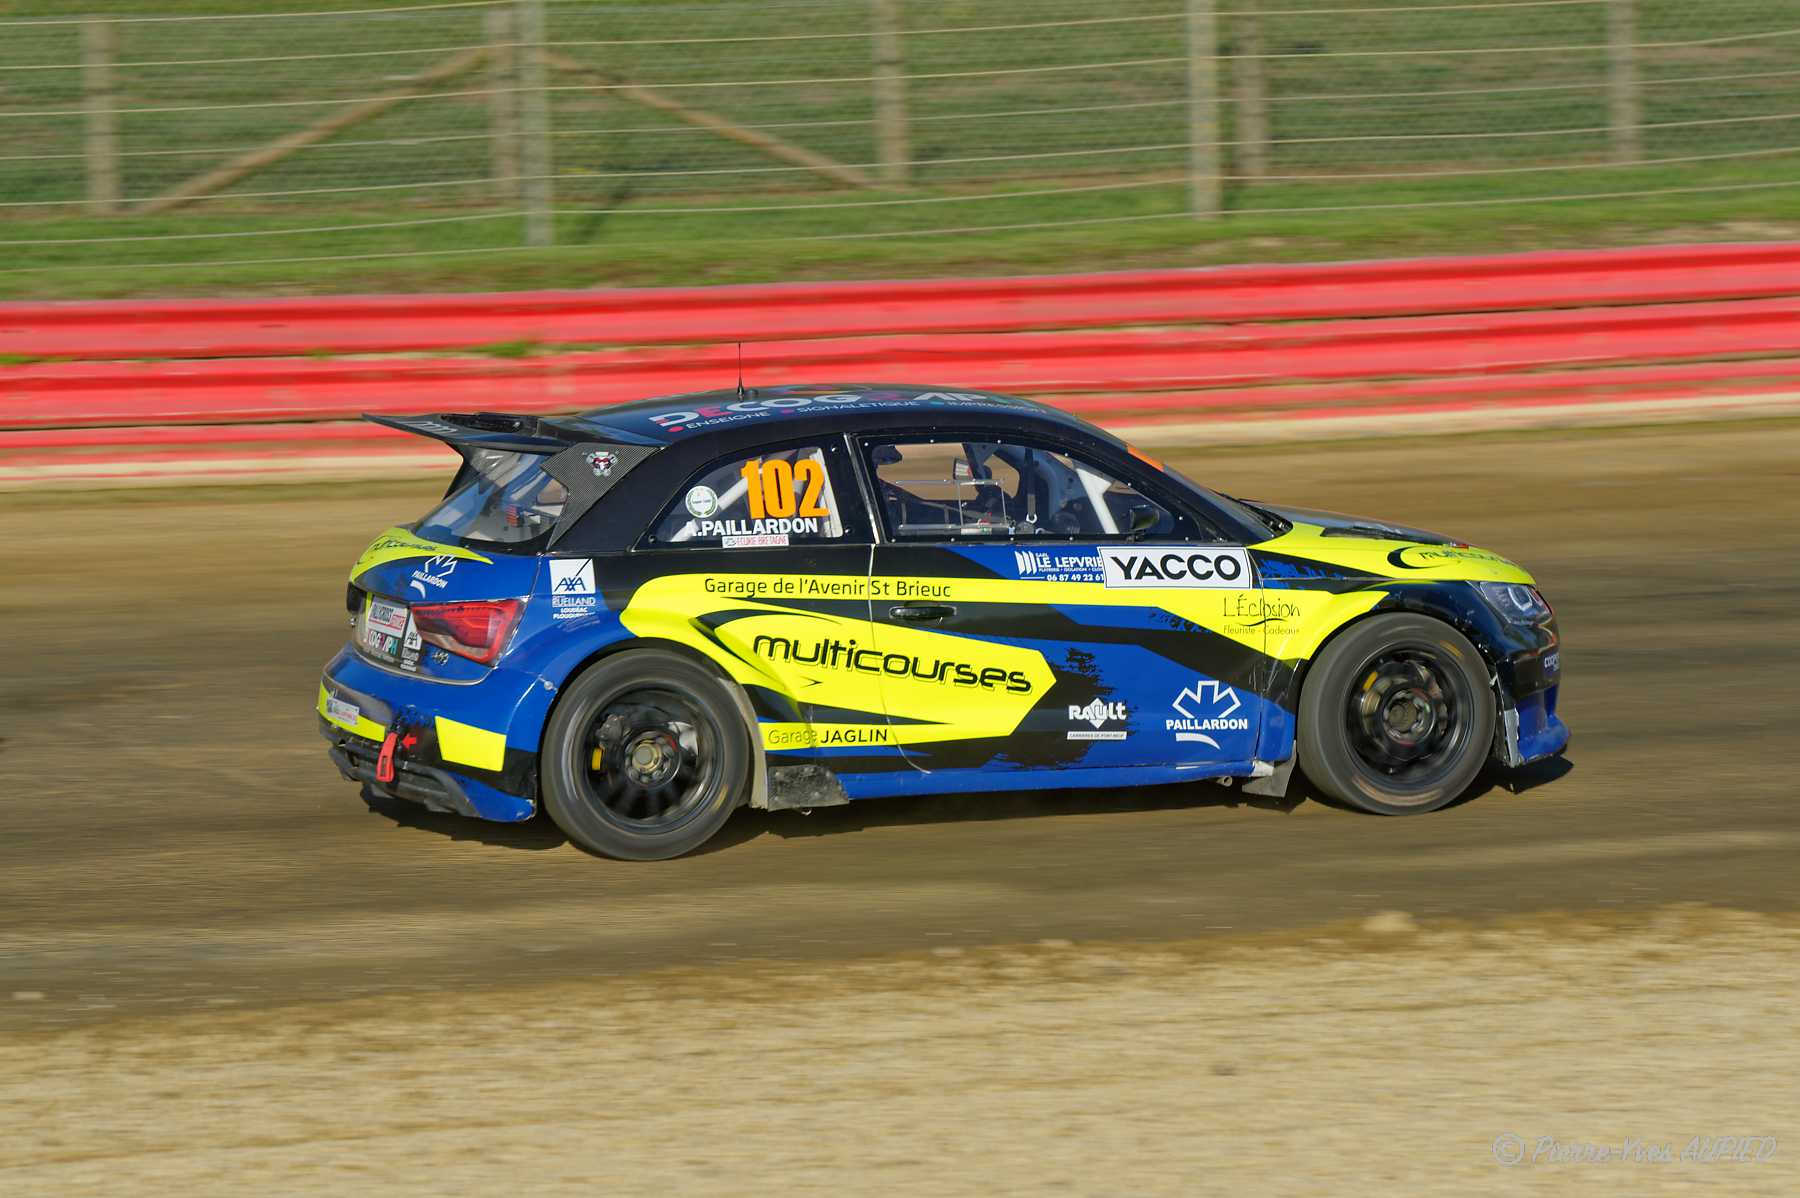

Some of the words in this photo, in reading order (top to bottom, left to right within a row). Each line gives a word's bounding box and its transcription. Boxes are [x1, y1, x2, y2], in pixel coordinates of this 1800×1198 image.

[686, 411, 771, 429] ENSEIGNE
[740, 458, 830, 519] 102
[685, 517, 818, 537] A.PAILLARDON
[1037, 557, 1051, 568] LE
[1111, 554, 1242, 581] YACCO
[554, 577, 586, 592] AXA
[1047, 574, 1057, 582] 06
[1059, 574, 1069, 582] 87
[1071, 574, 1082, 582] 49
[1083, 574, 1094, 582] 22
[705, 578, 767, 597] Garage
[773, 578, 794, 594] de
[799, 579, 865, 595] l'Avenir
[871, 580, 889, 595] St
[897, 581, 951, 597] Brieuc
[753, 635, 1033, 694] multicourses
[1165, 719, 1248, 731] PAILLARDON
[768, 729, 817, 744] Garage
[821, 729, 888, 743] JAGLIN
